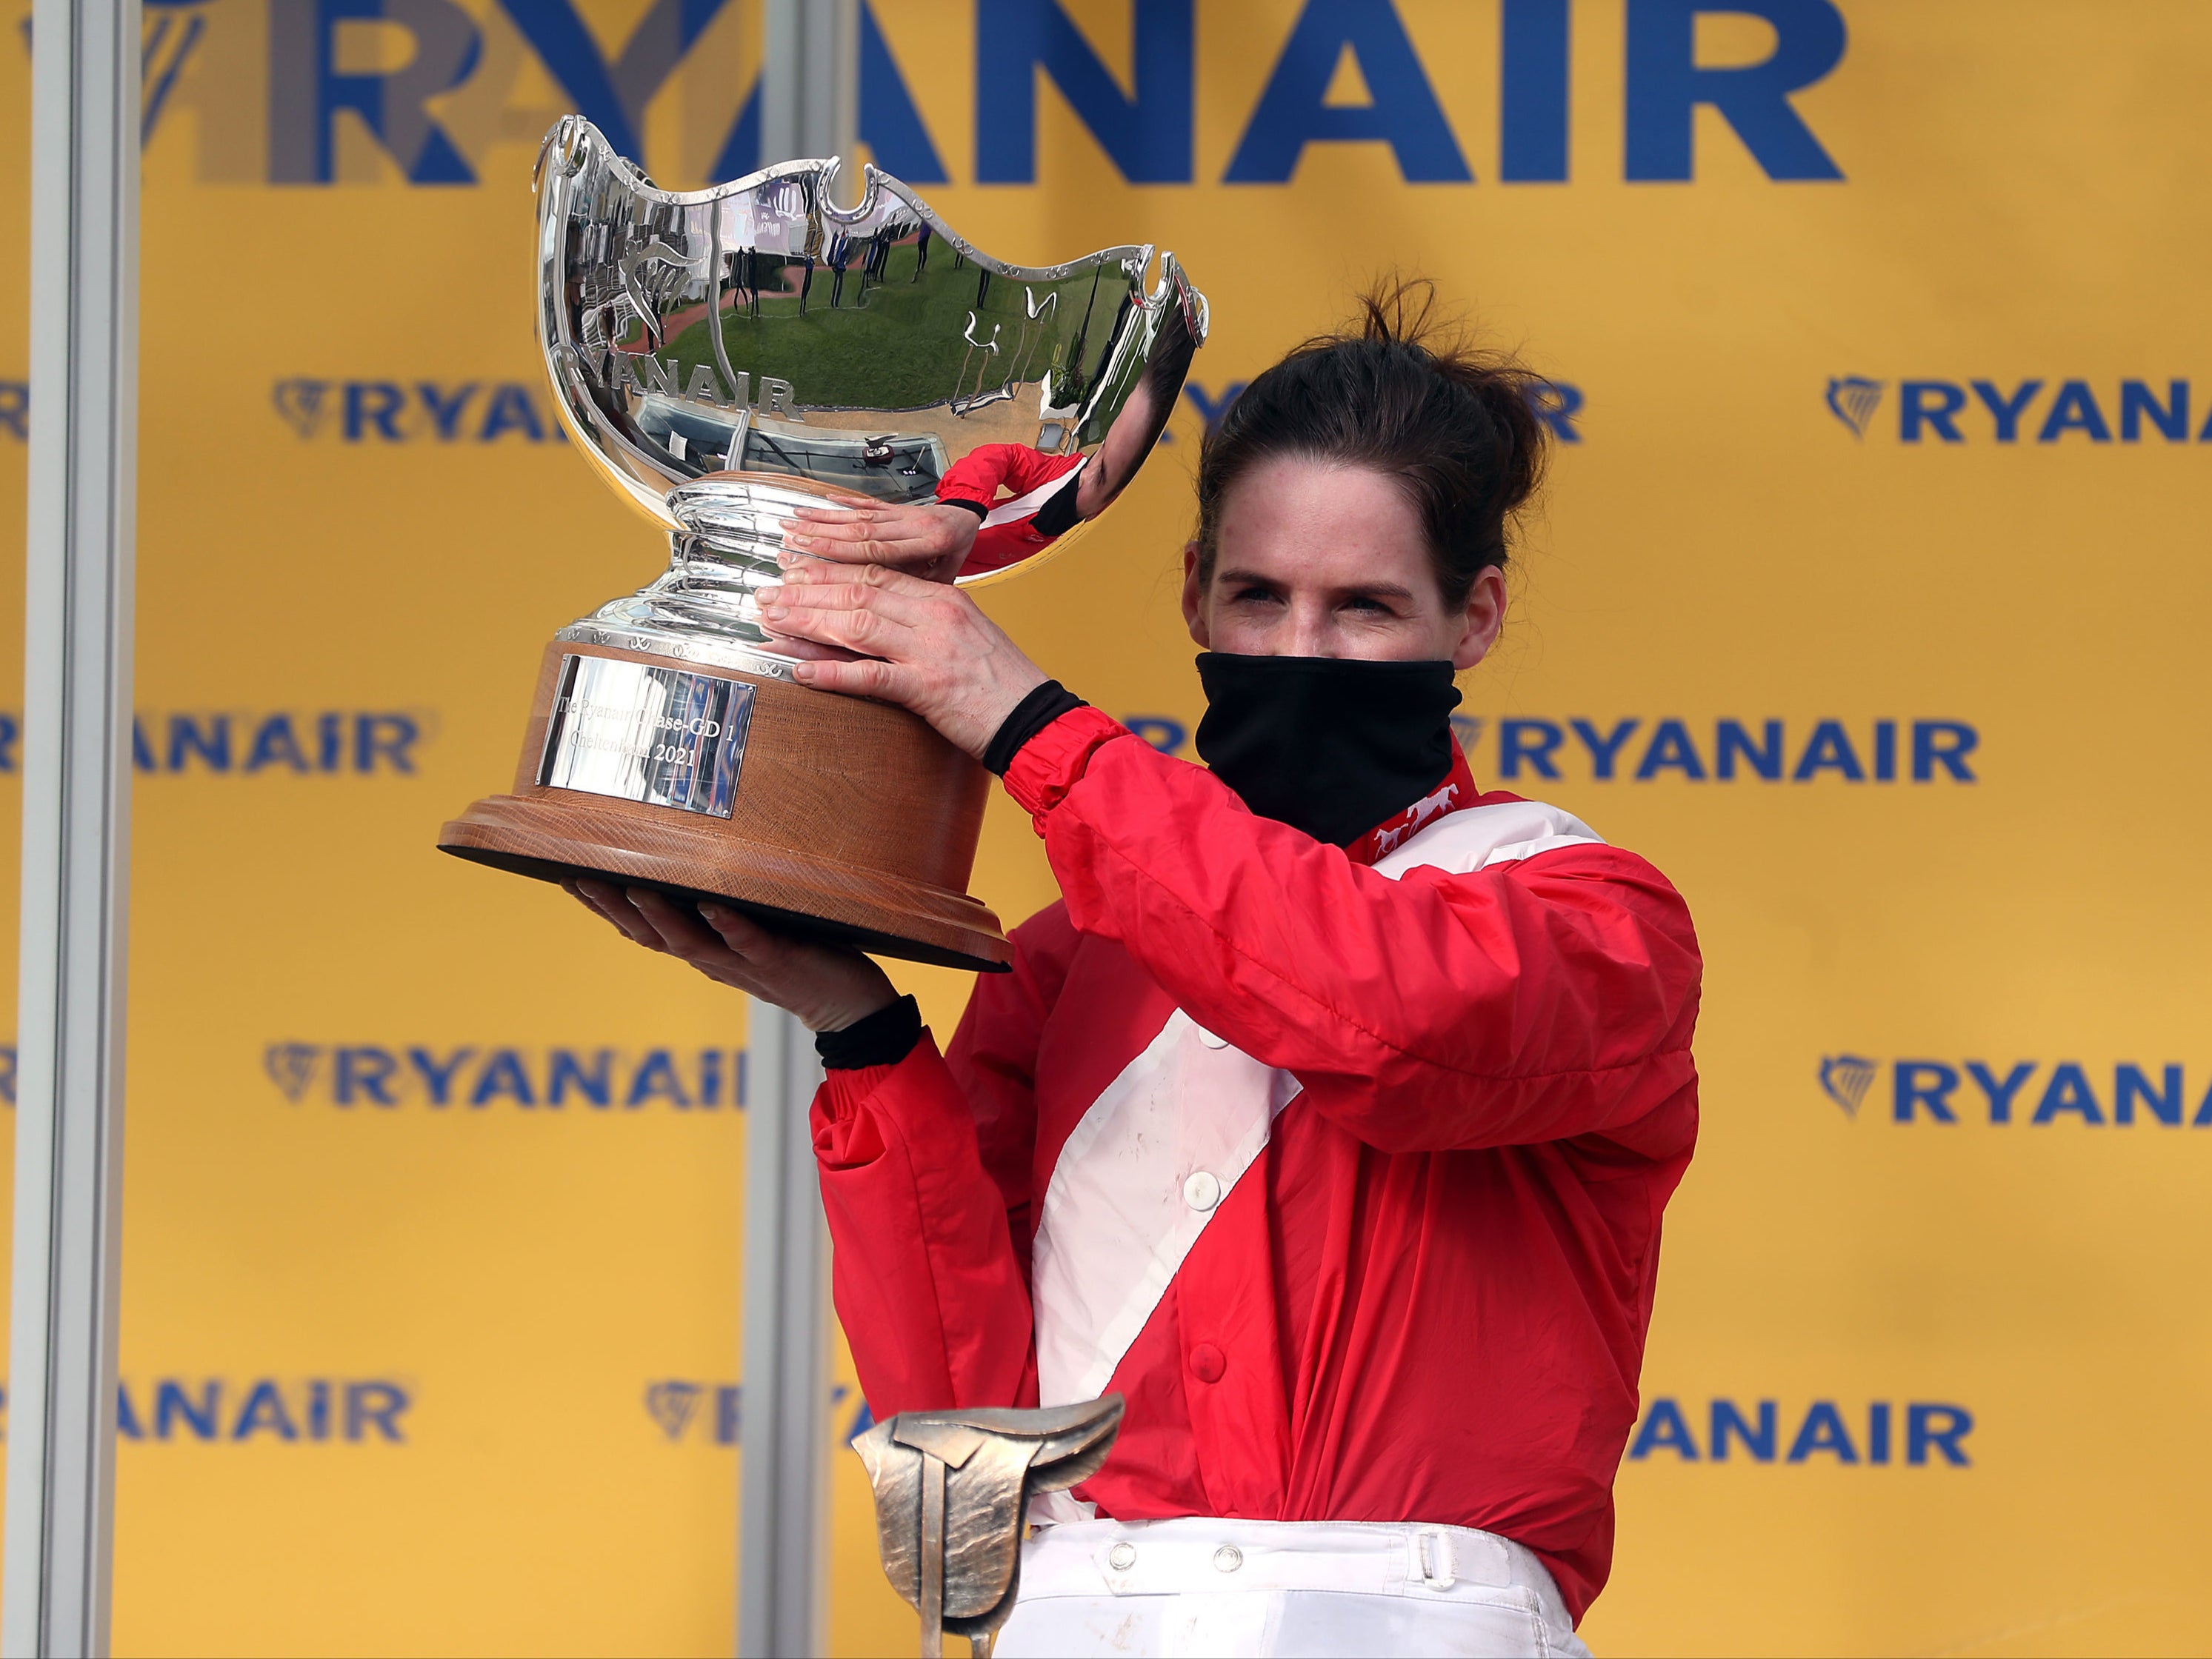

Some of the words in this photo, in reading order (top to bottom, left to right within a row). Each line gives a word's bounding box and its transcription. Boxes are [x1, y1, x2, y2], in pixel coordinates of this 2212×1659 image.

[267, 0, 1848, 184] RYANAIR
[342, 381, 570, 442] RYA
[559, 344, 804, 423] RYANAIR
[1899, 378, 2212, 443] RYAN
[558, 695, 577, 714] The
[654, 743, 696, 767] 2021
[1496, 717, 1979, 784] RYANAIR
[335, 1047, 747, 1109] RYANAI
[1892, 1059, 2212, 1126] RYAN
